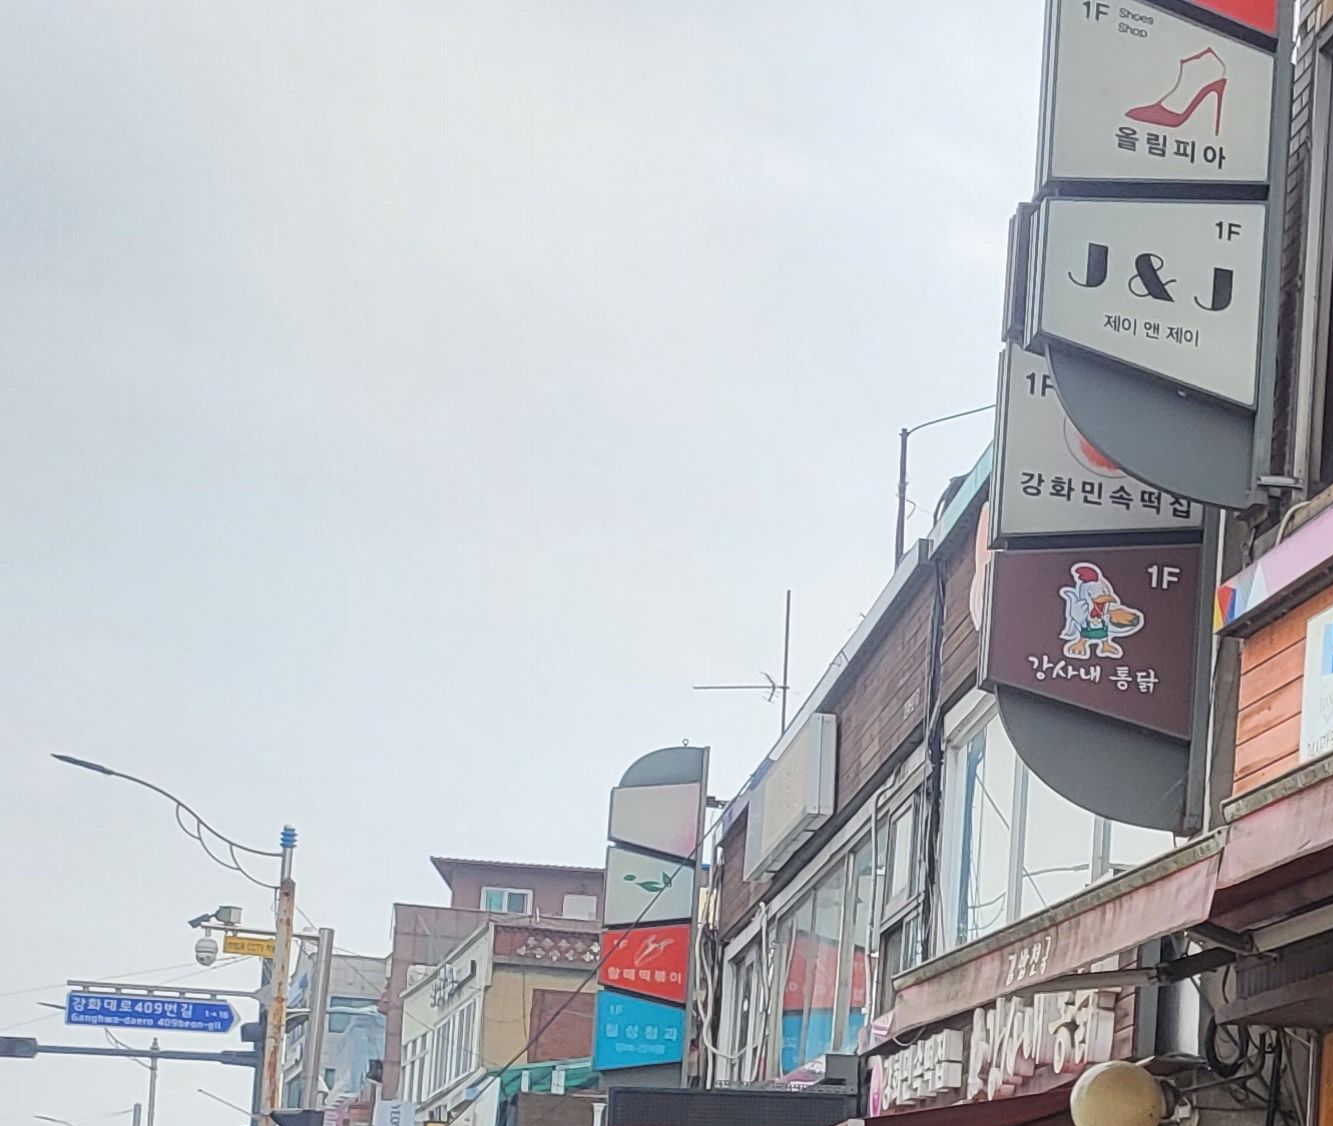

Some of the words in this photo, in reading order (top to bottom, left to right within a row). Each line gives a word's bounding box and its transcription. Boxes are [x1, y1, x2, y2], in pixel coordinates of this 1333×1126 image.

[1083, 1, 1109, 21] 1F
[1119, 7, 1154, 25] Shoes
[1118, 22, 1148, 38] Shop
[1115, 126, 1226, 169] 올림피아
[1215, 221, 1242, 241] 1F
[1103, 314, 1137, 336] 제이
[1143, 321, 1160, 340] 앤
[1165, 326, 1199, 347] 제이
[1025, 372, 1055, 398] 1F
[1020, 472, 1192, 520] 강화민속떡집
[1147, 564, 1181, 591] 1F
[1028, 655, 1101, 683] 강사내
[72, 997, 193, 1018] 강화대로409번길
[71, 1014, 153, 1026] Ganghwa-daero
